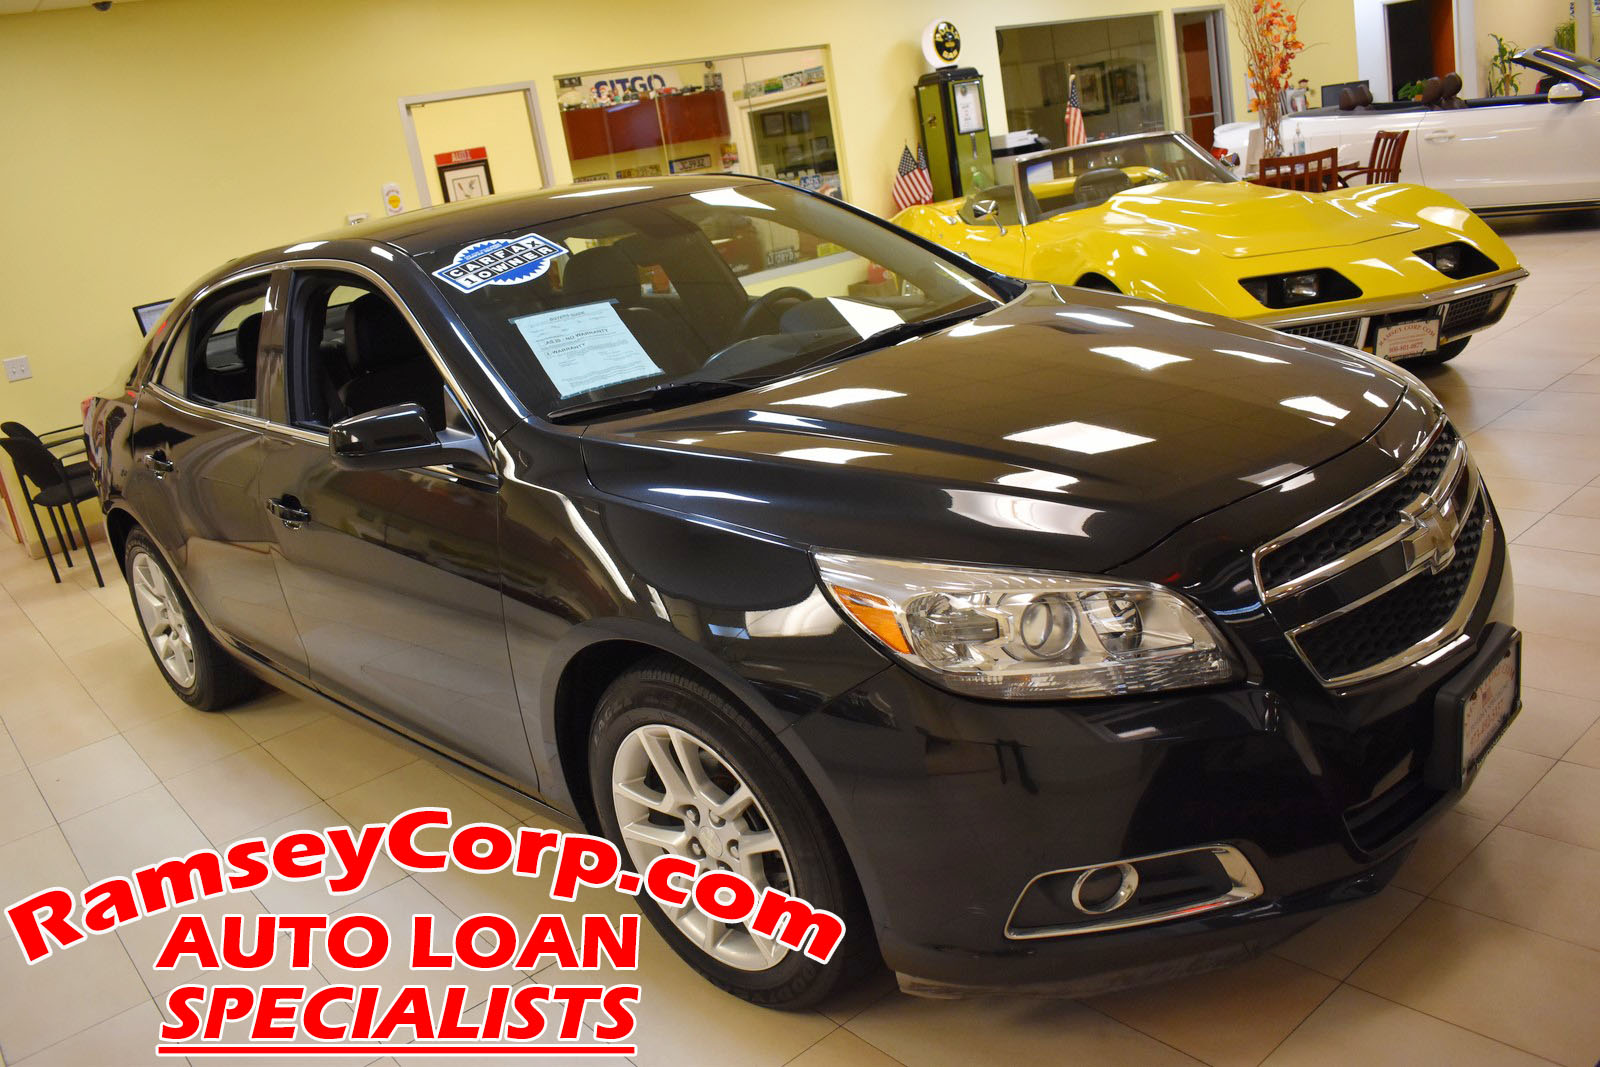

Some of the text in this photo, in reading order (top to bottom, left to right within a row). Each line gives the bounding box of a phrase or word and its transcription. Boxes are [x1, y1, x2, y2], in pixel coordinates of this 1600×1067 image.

[449, 240, 542, 278] CARFAX
[463, 276, 478, 286] 1
[478, 246, 554, 279] OWNER
[575, 328, 609, 338] WARRANTY
